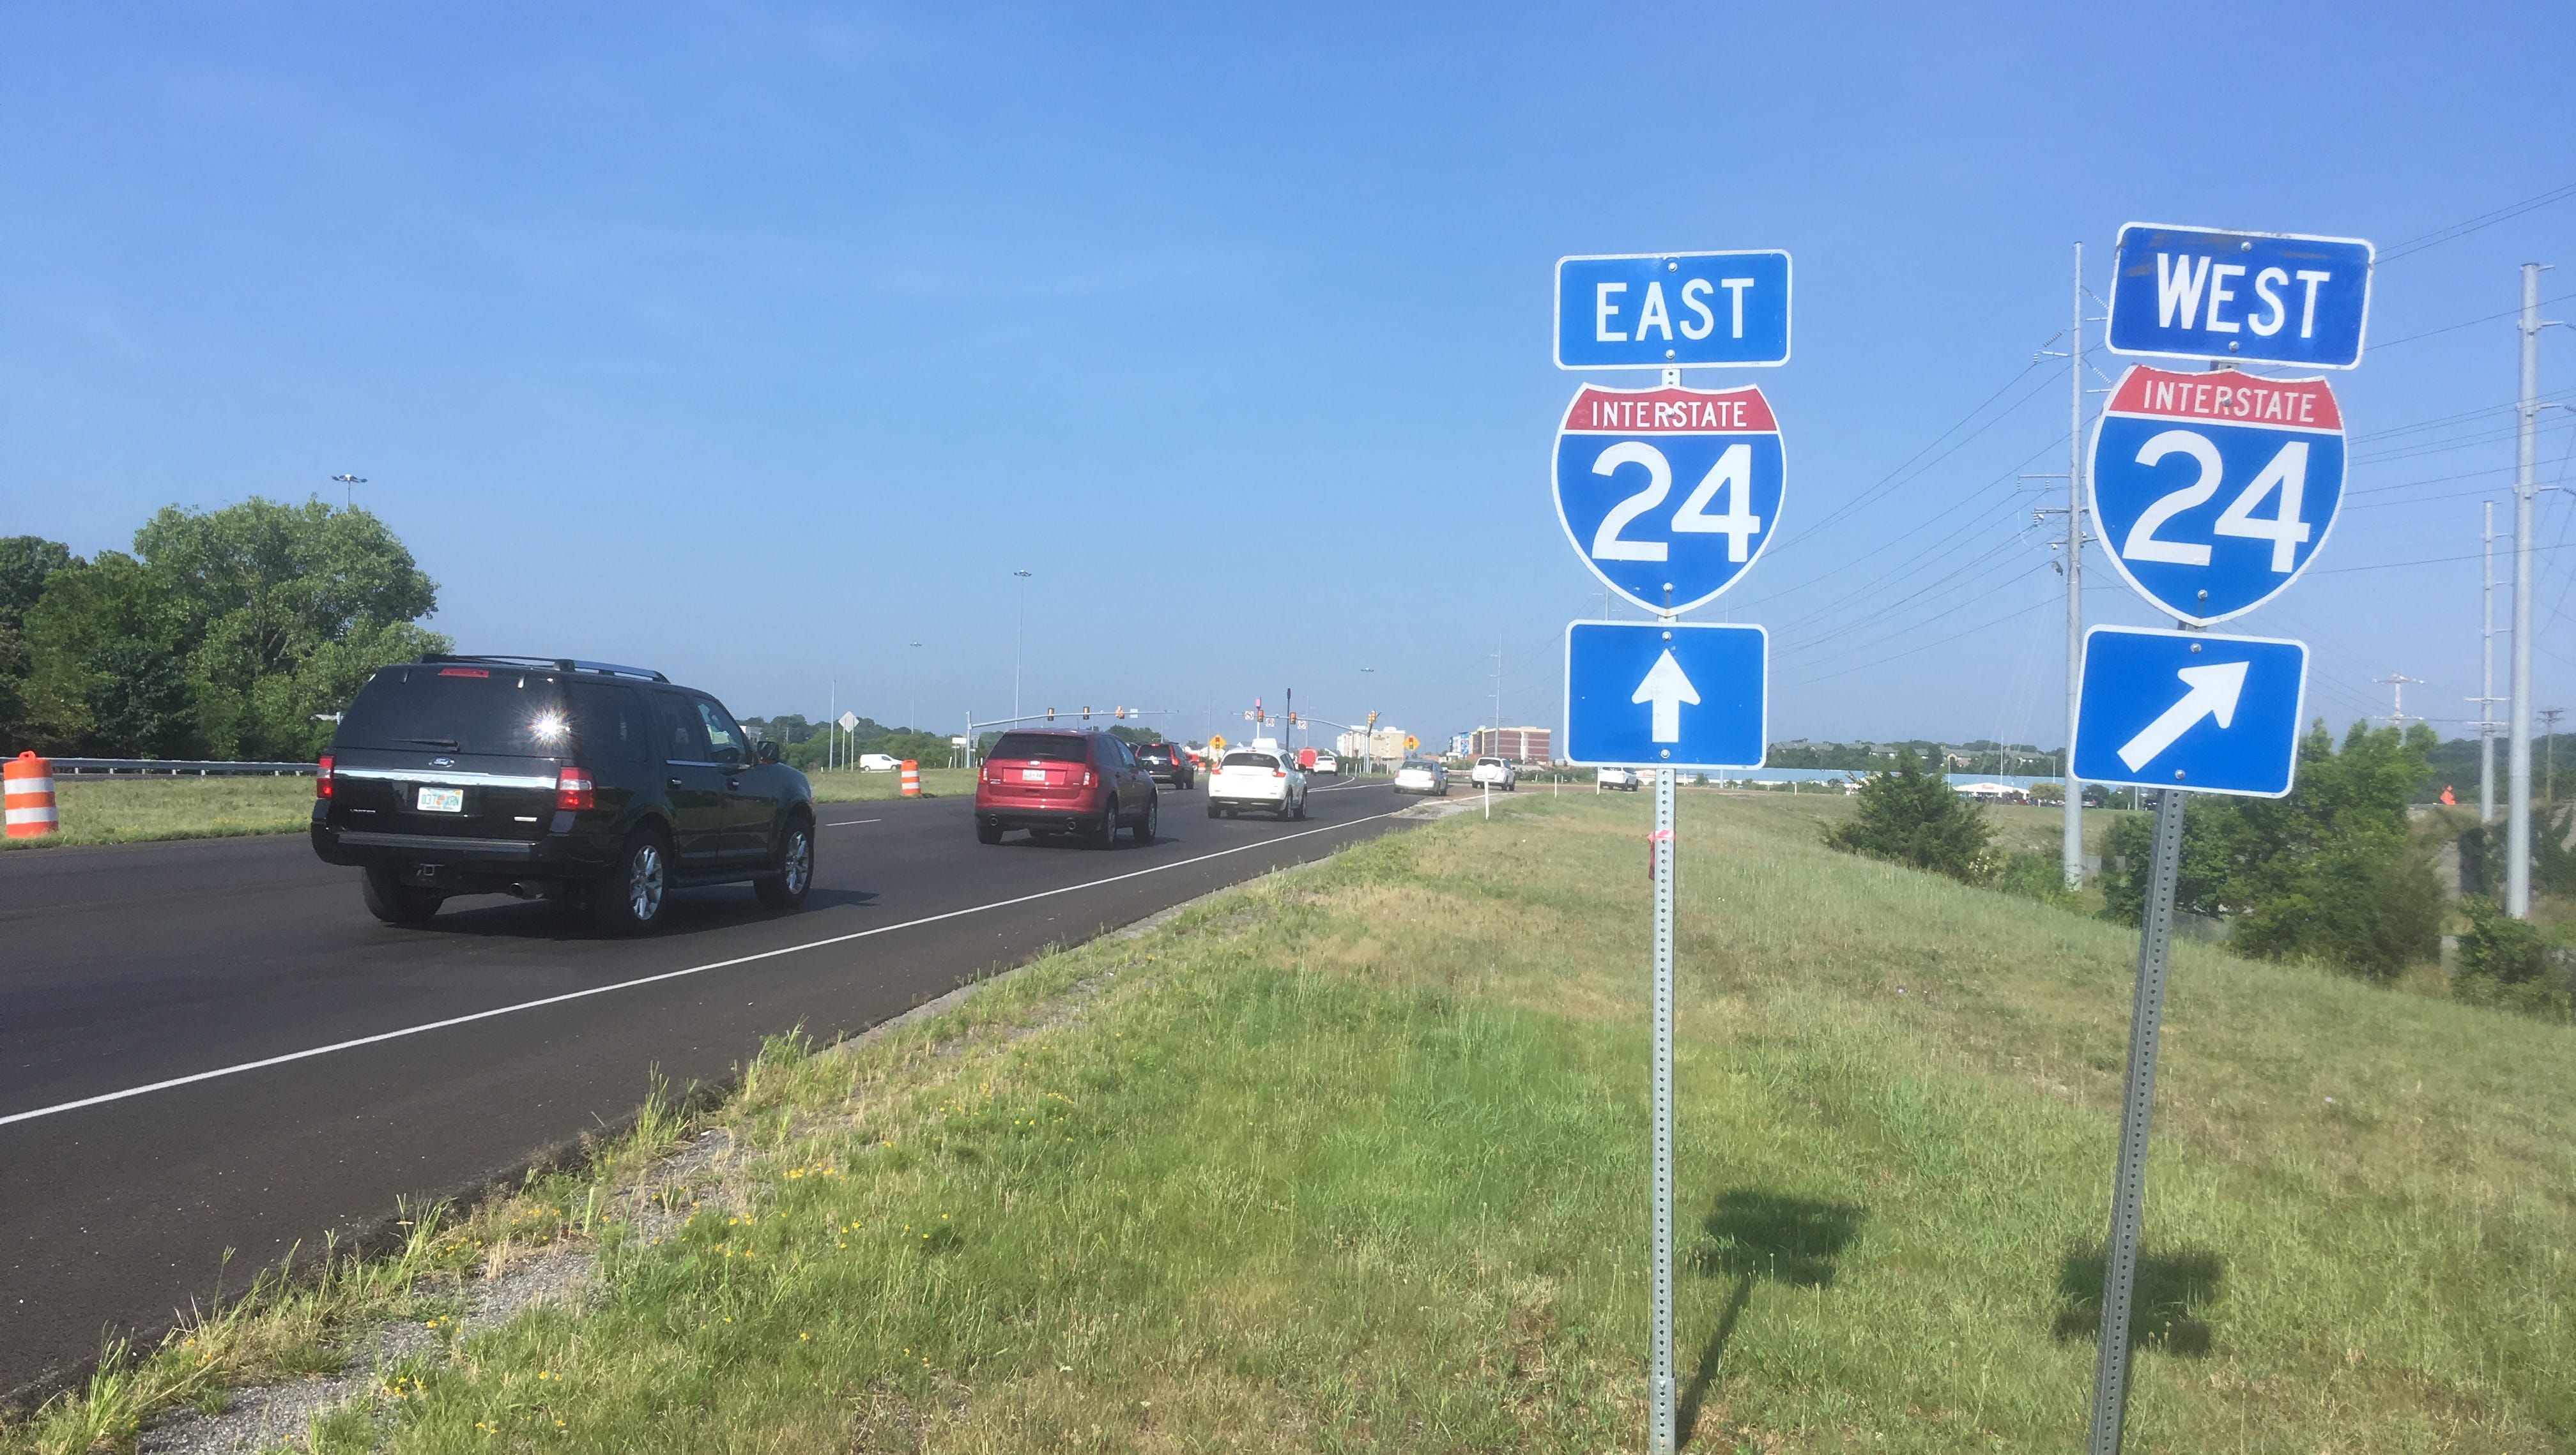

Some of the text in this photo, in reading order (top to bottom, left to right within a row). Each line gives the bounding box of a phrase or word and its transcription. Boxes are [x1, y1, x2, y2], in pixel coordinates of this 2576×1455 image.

[1596, 278, 1754, 342] EAST
[2157, 253, 2331, 339] WEST
[1592, 401, 1747, 427] INTERSTATE
[2143, 380, 2317, 422] INTERSTATE
[1591, 441, 1761, 562] 24
[2122, 430, 2311, 573] 24
